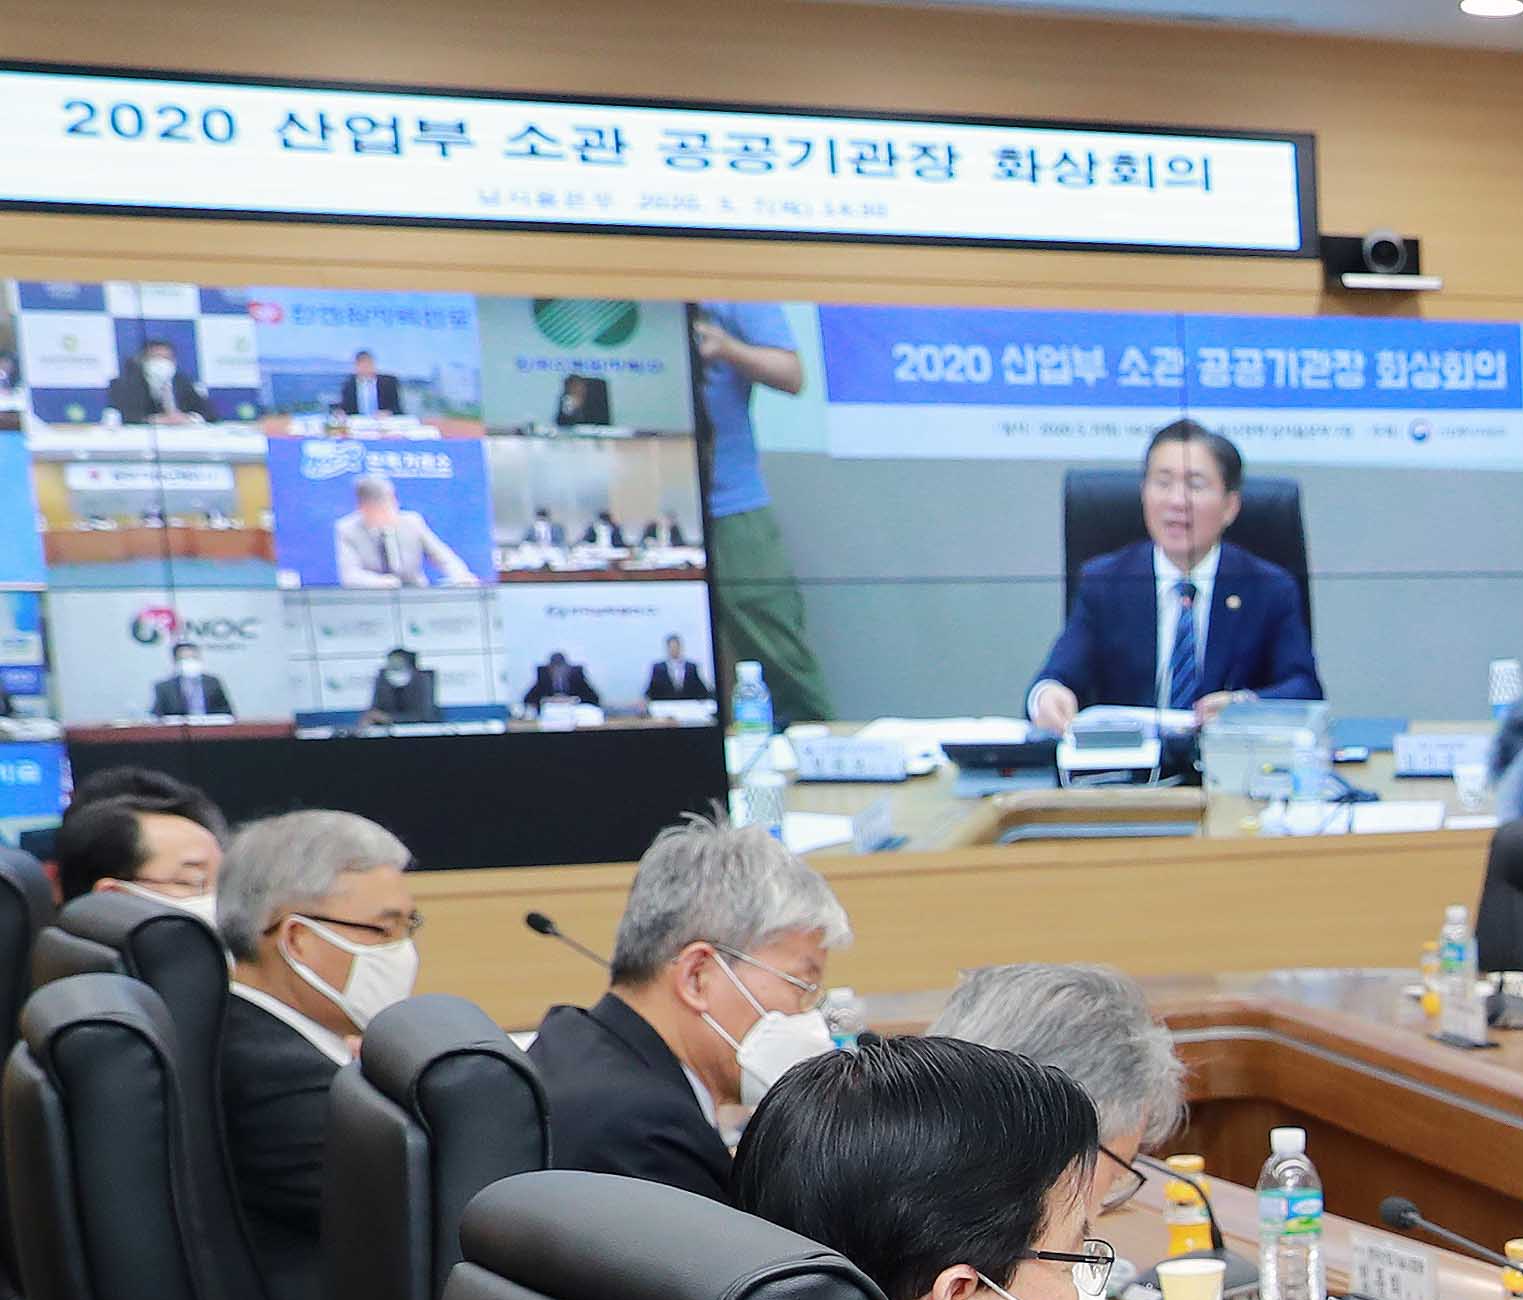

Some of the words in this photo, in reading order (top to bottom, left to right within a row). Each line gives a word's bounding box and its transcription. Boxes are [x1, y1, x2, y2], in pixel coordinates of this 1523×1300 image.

[64, 99, 238, 145] 2020
[276, 110, 476, 159] 산업부
[505, 122, 629, 166] 소관
[661, 126, 961, 181] 공공기관장
[993, 146, 1214, 192] 화상회의
[891, 343, 993, 383] 2020
[1000, 343, 1110, 388] 산업부
[1116, 345, 1186, 388] 소관
[1197, 346, 1368, 390] 공공기관장
[1375, 348, 1510, 391] 화상회의
